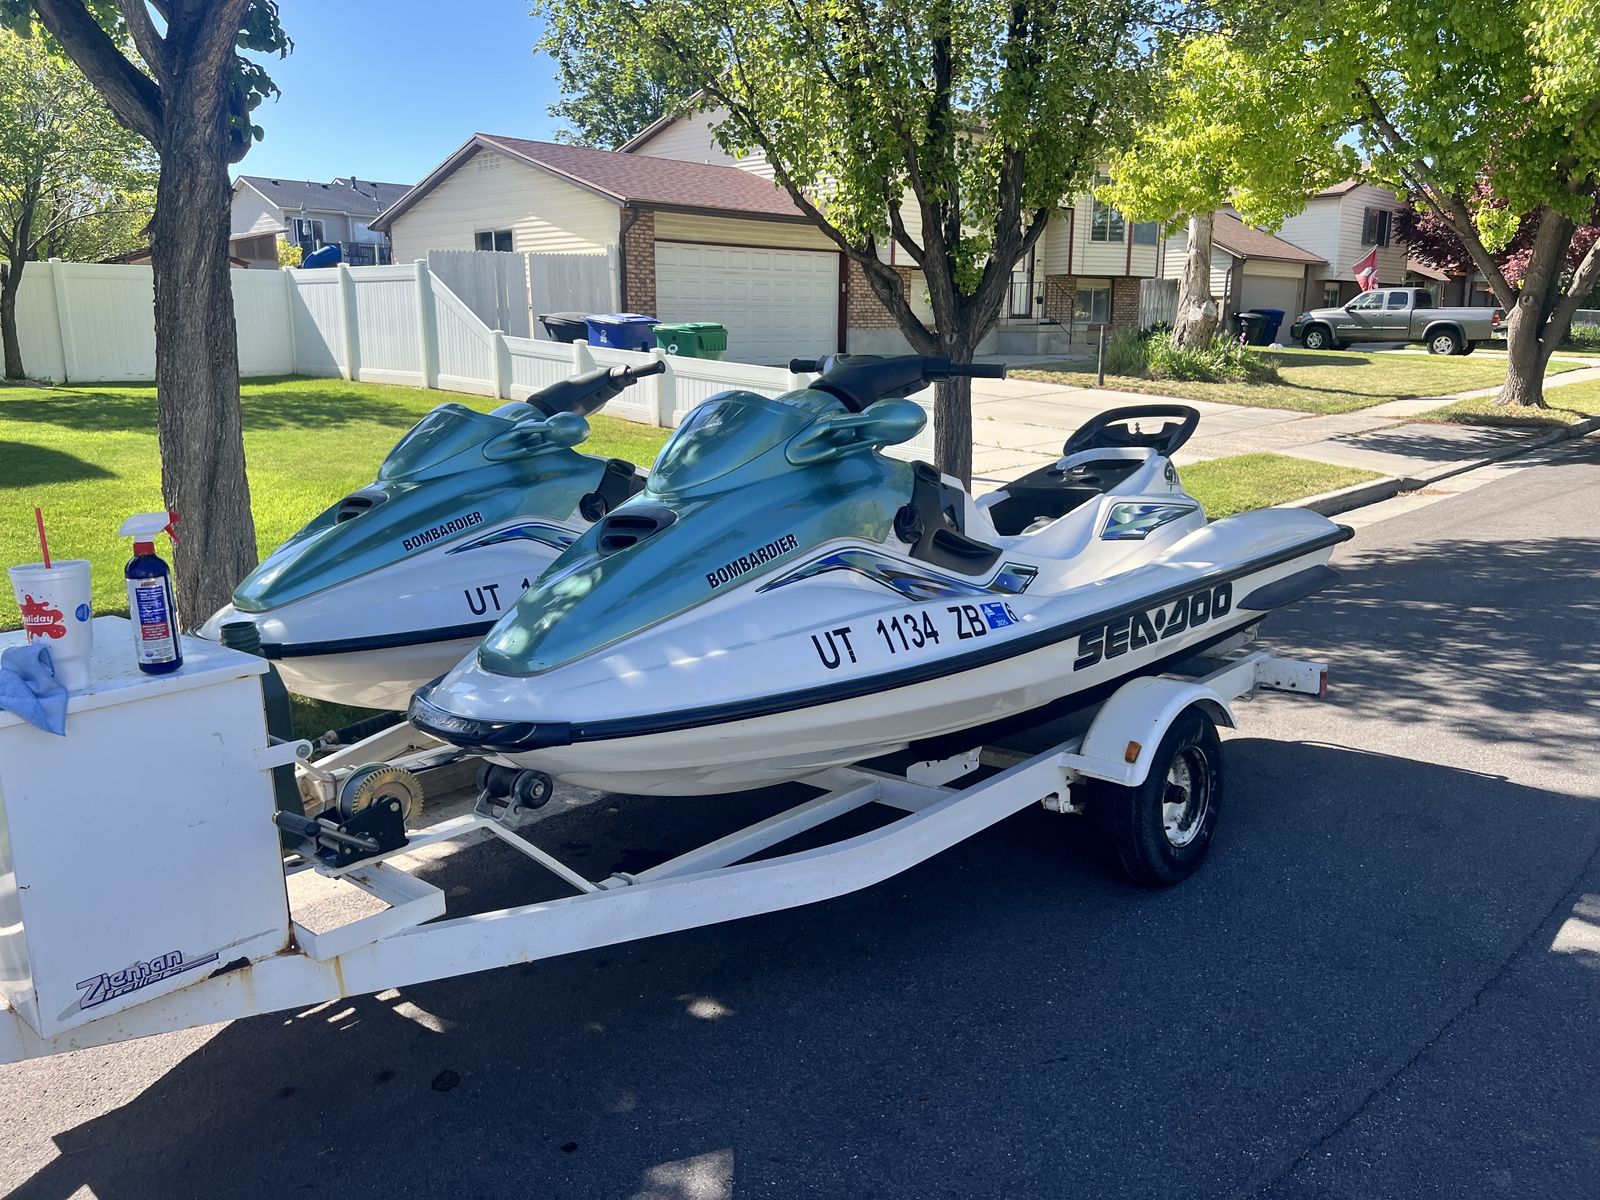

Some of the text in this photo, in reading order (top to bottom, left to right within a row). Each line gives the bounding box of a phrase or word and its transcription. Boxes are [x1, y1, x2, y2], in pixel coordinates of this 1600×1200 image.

[402, 511, 484, 552] BOMBARDIER
[705, 533, 799, 590] BOMBARDIER
[23, 614, 54, 626] oliday
[464, 583, 502, 616] UT
[811, 604, 987, 670] UT 1134 ZB
[76, 950, 184, 1011] Zieman
